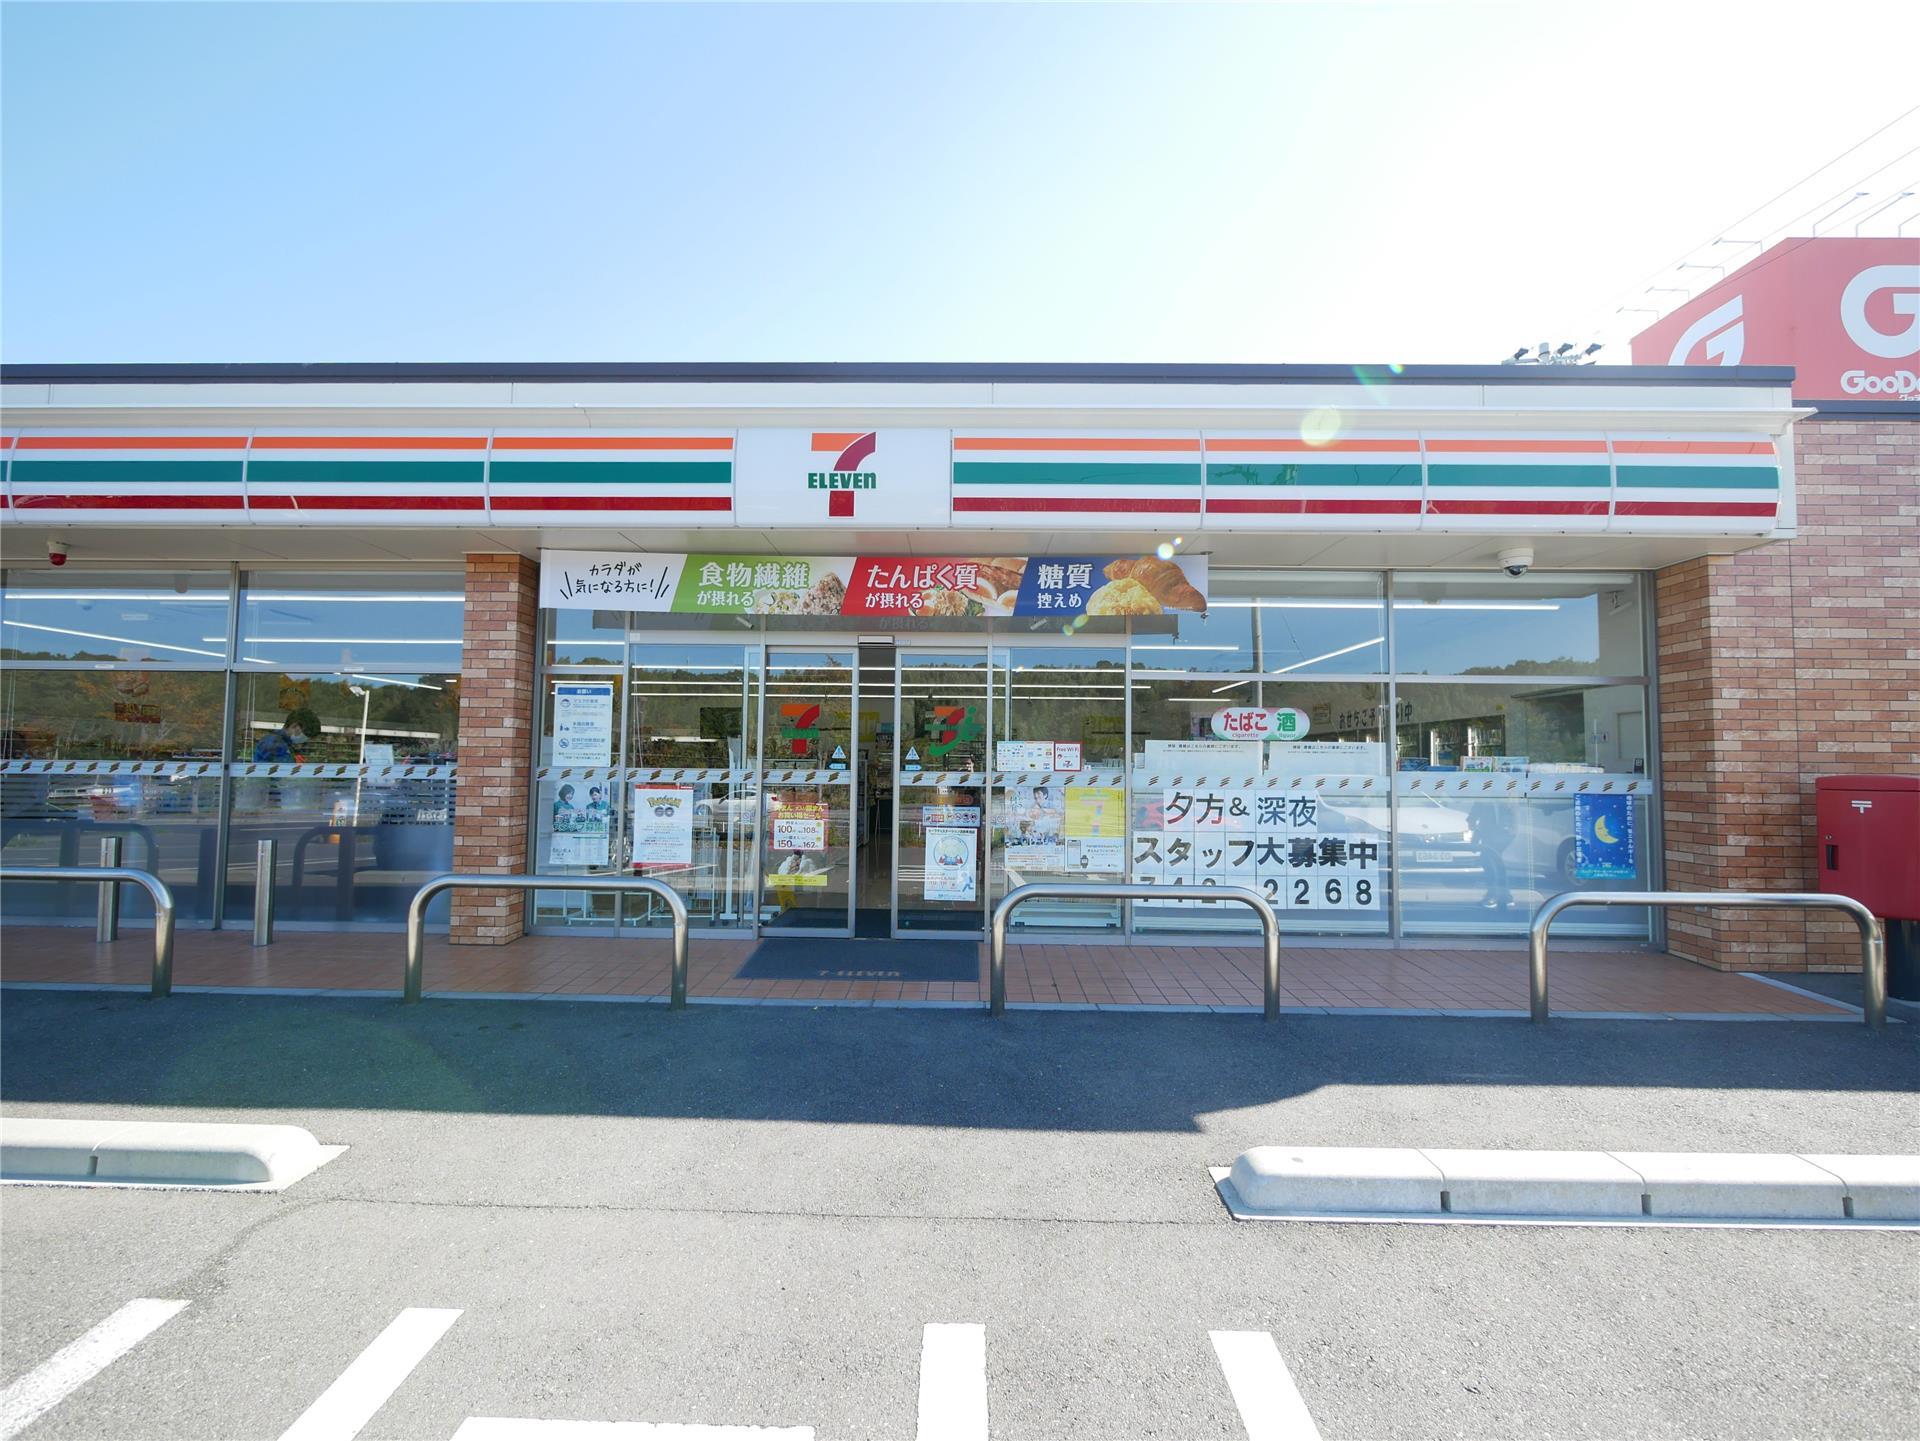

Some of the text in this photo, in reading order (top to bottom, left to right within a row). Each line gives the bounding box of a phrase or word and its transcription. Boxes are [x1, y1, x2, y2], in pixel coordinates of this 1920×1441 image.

[1841, 370, 1920, 394] GooD
[589, 561, 642, 576] カラダが
[699, 562, 810, 588] 食物繊維
[866, 564, 979, 590] たんぱく質
[1037, 564, 1093, 589] 糖質
[697, 591, 754, 606] が摂れる
[865, 593, 923, 608] が摂れる
[1037, 593, 1082, 608] 控えめ
[1223, 712, 1296, 731] たばこ 酒
[1134, 837, 1378, 869] スタッフ大募集中
